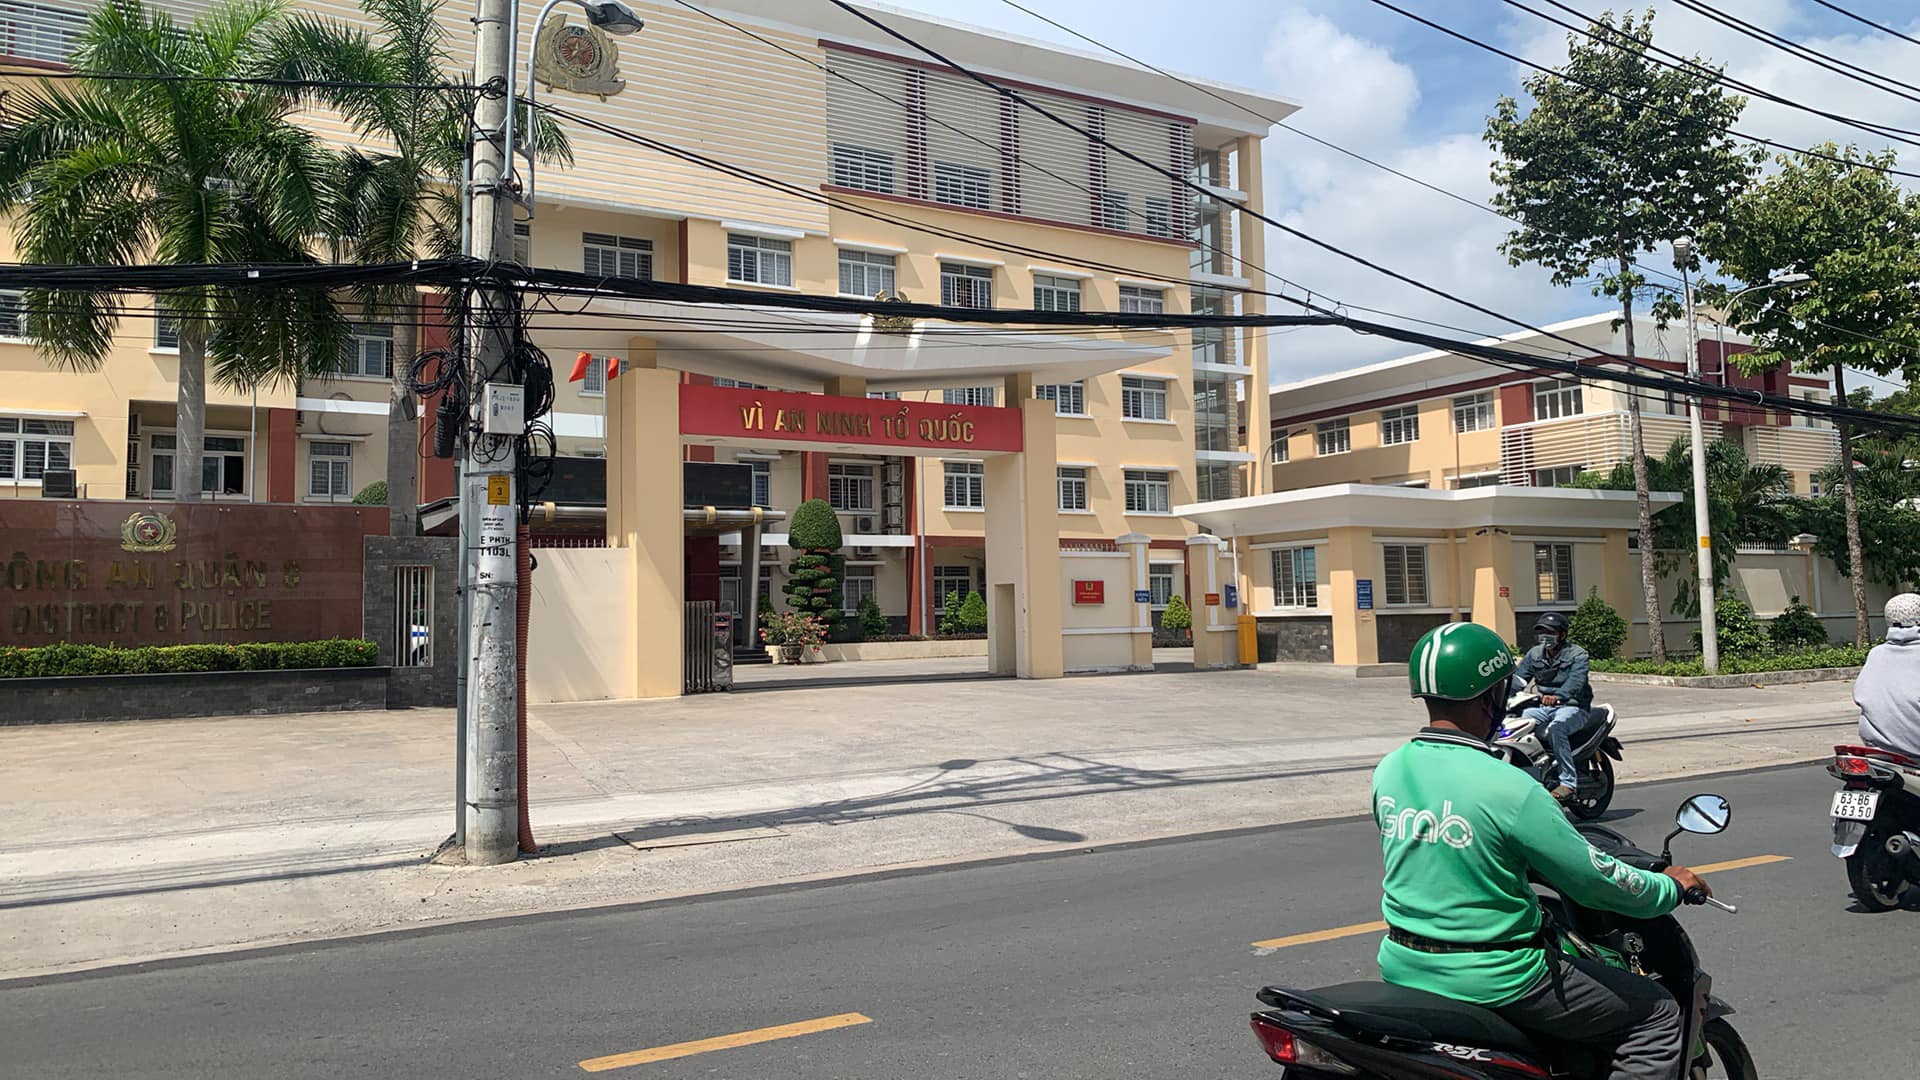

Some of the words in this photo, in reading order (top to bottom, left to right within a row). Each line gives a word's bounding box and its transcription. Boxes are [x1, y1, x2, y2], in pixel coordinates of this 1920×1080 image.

[740, 401, 764, 430] VÌ
[774, 409, 805, 433] AN
[816, 411, 872, 437] NINH
[882, 406, 909, 439] TỔ
[919, 412, 975, 443] QUỐC
[0, 552, 87, 590] ÔNG
[106, 560, 154, 590] AN
[174, 552, 267, 595] QUẬN
[12, 601, 144, 634] DISTRICT
[154, 603, 168, 632] 8
[181, 601, 272, 631] POLICE
[1478, 649, 1508, 677] Grab
[1378, 795, 1473, 849] Grab
